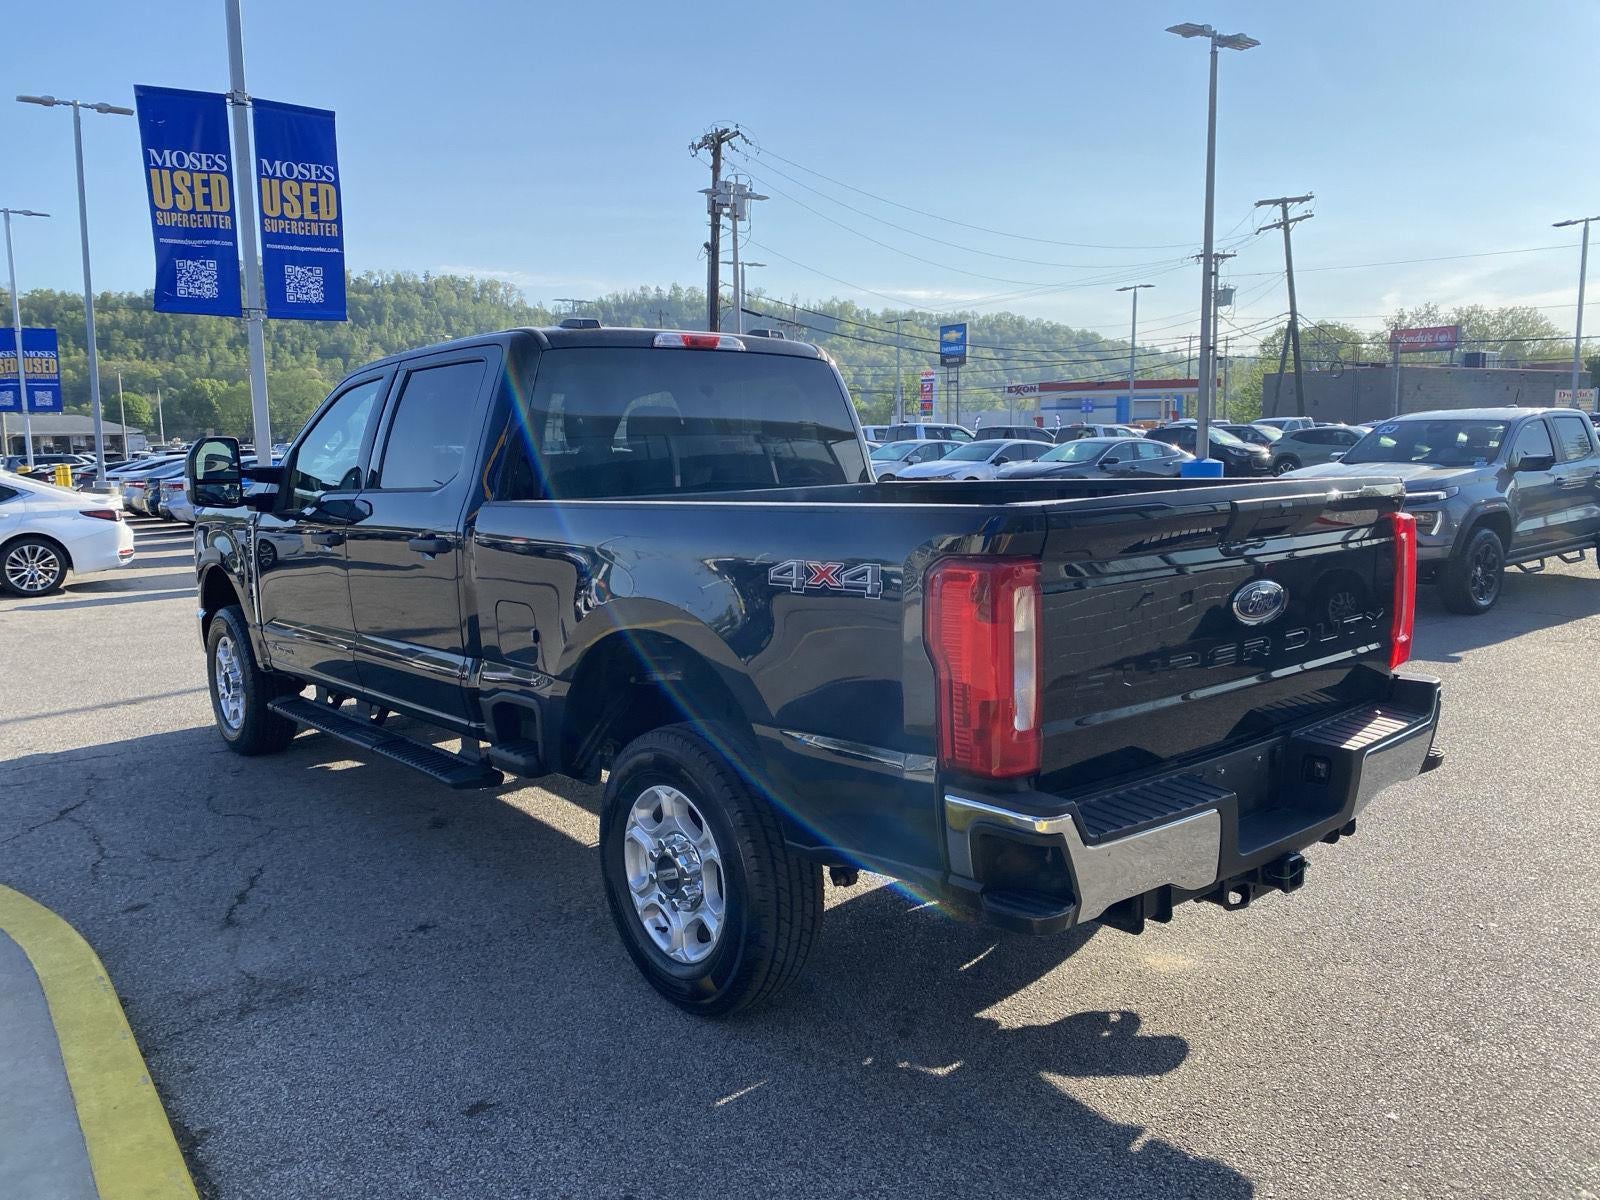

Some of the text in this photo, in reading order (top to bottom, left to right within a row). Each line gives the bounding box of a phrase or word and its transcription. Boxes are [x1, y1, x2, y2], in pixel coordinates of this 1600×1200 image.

[147, 148, 228, 172] MOSES
[260, 158, 335, 182] MOSES
[149, 168, 231, 213] USED
[261, 177, 338, 221] USED
[156, 211, 232, 230] SUPERCENTER
[264, 218, 338, 237] SUPERCENTER
[23, 350, 57, 358] MOSES
[24, 357, 58, 373] USED
[1007, 383, 1037, 396] EXXON
[1248, 589, 1276, 614] Ford
[1285, 607, 1385, 651] DUTY
